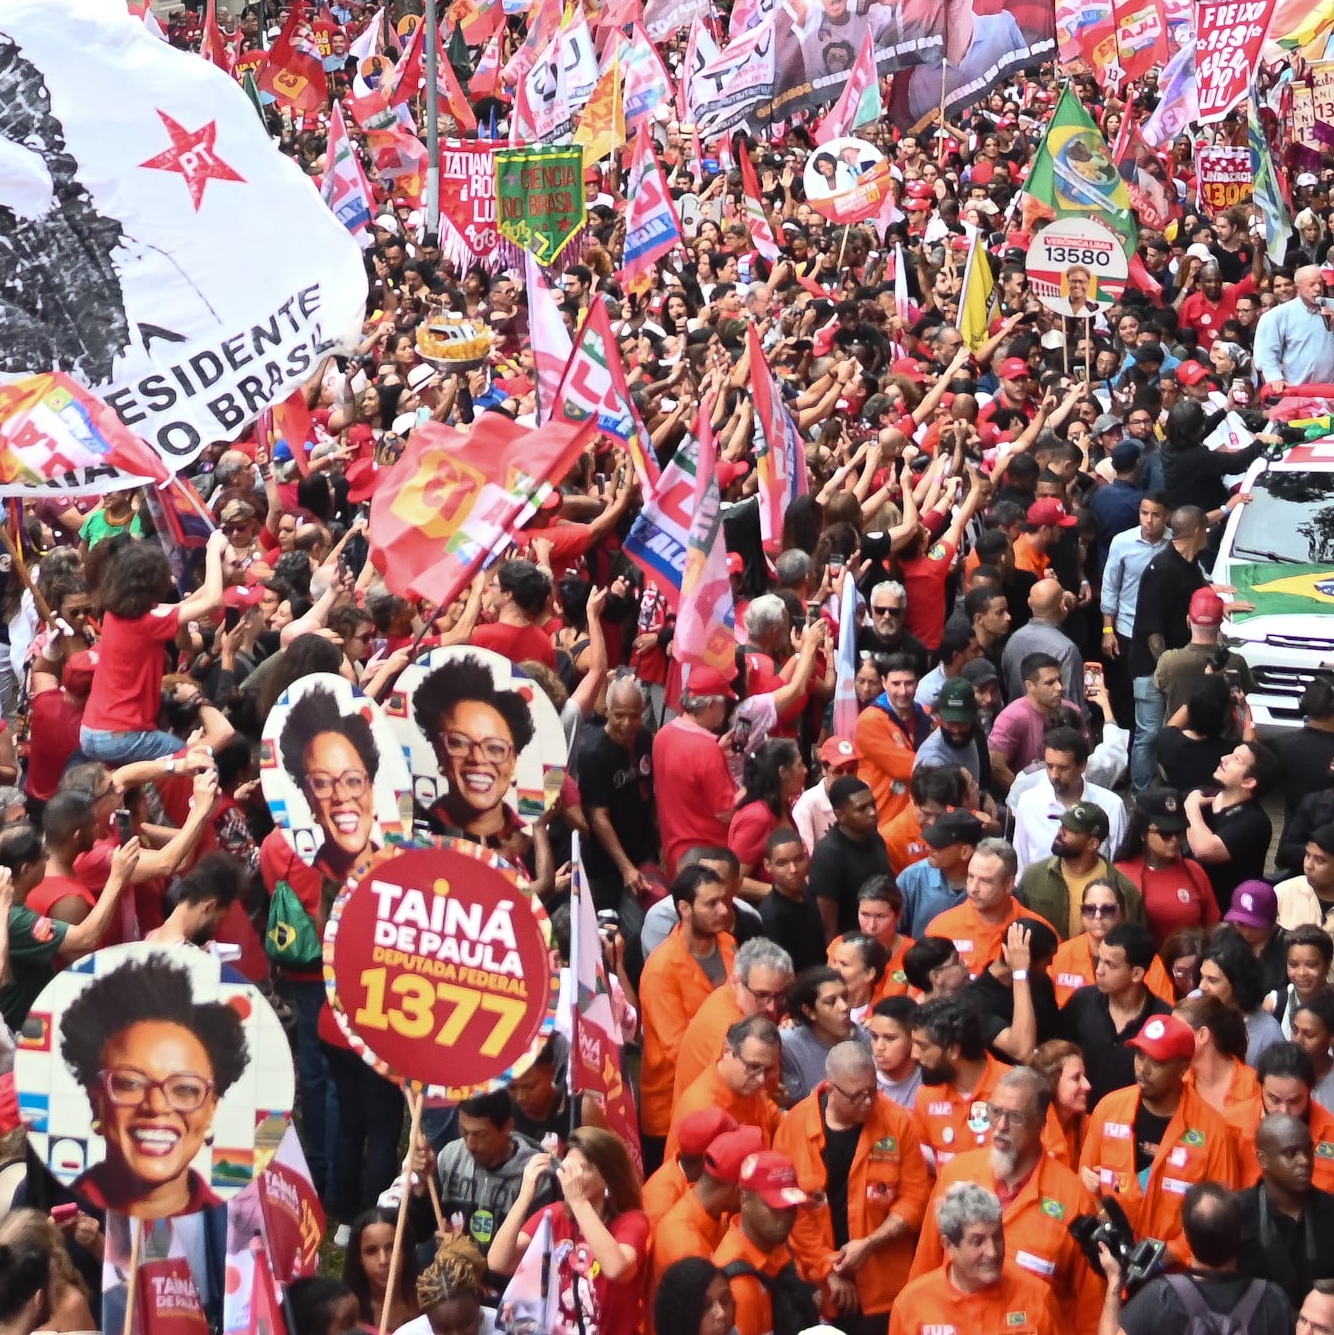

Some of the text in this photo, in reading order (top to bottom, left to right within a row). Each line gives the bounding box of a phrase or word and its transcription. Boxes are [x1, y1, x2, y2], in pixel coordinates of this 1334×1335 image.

[1203, 1, 1267, 28] FREIXO
[177, 142, 214, 177] PT
[443, 152, 494, 176] TATIAN
[520, 161, 577, 191] CIÊNCIA
[502, 191, 578, 218] NO BRASIL
[1204, 183, 1254, 206] 1300
[473, 200, 496, 222] LU
[1045, 247, 1110, 266] 13580
[105, 282, 324, 427] ESIDENTE
[157, 419, 202, 458] O
[374, 920, 524, 979] DE PAULA
[373, 946, 528, 998] DEPUTADA FEDERAL
[355, 967, 528, 1059] 1377
